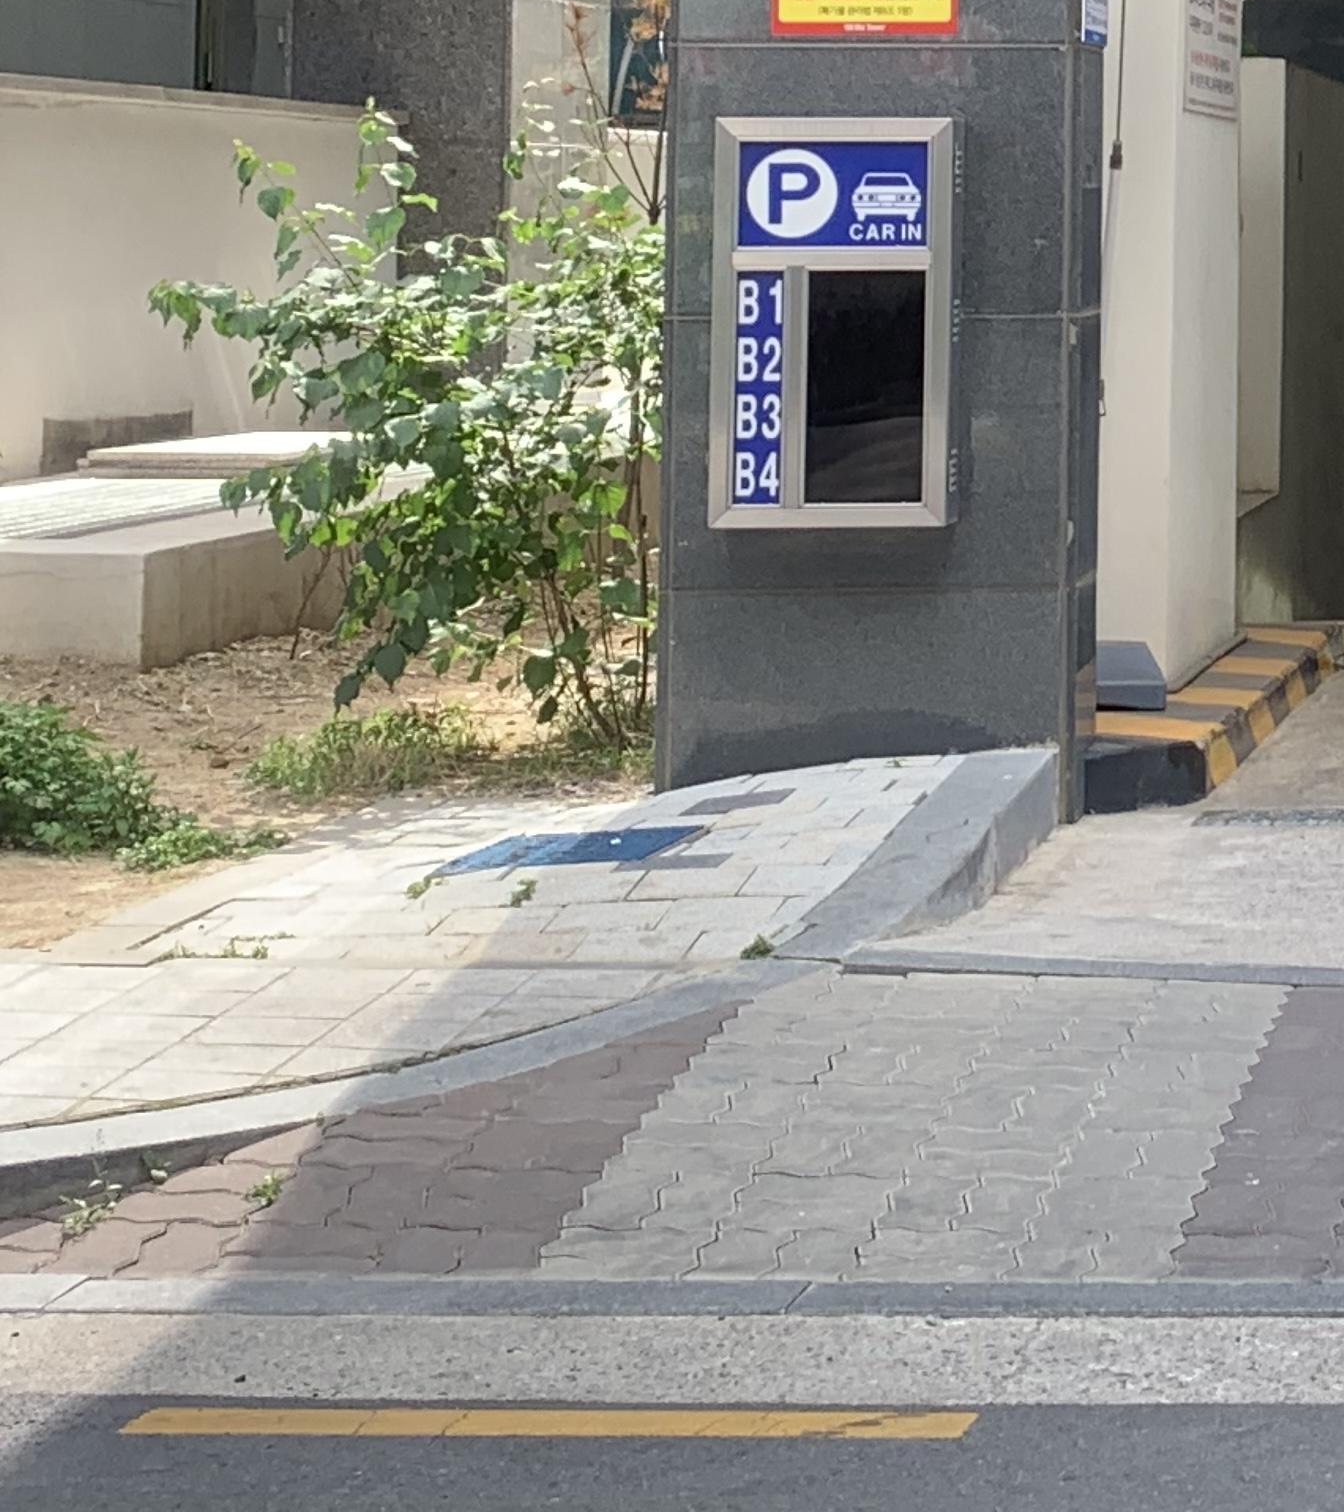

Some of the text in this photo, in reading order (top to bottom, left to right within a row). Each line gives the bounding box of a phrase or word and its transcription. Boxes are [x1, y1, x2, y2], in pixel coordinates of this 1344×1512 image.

[768, 163, 821, 225] P
[848, 222, 922, 241] CAR IN
[738, 279, 782, 325] B1
[737, 337, 782, 382] B2
[736, 394, 782, 440] B3
[735, 452, 779, 497] B4
